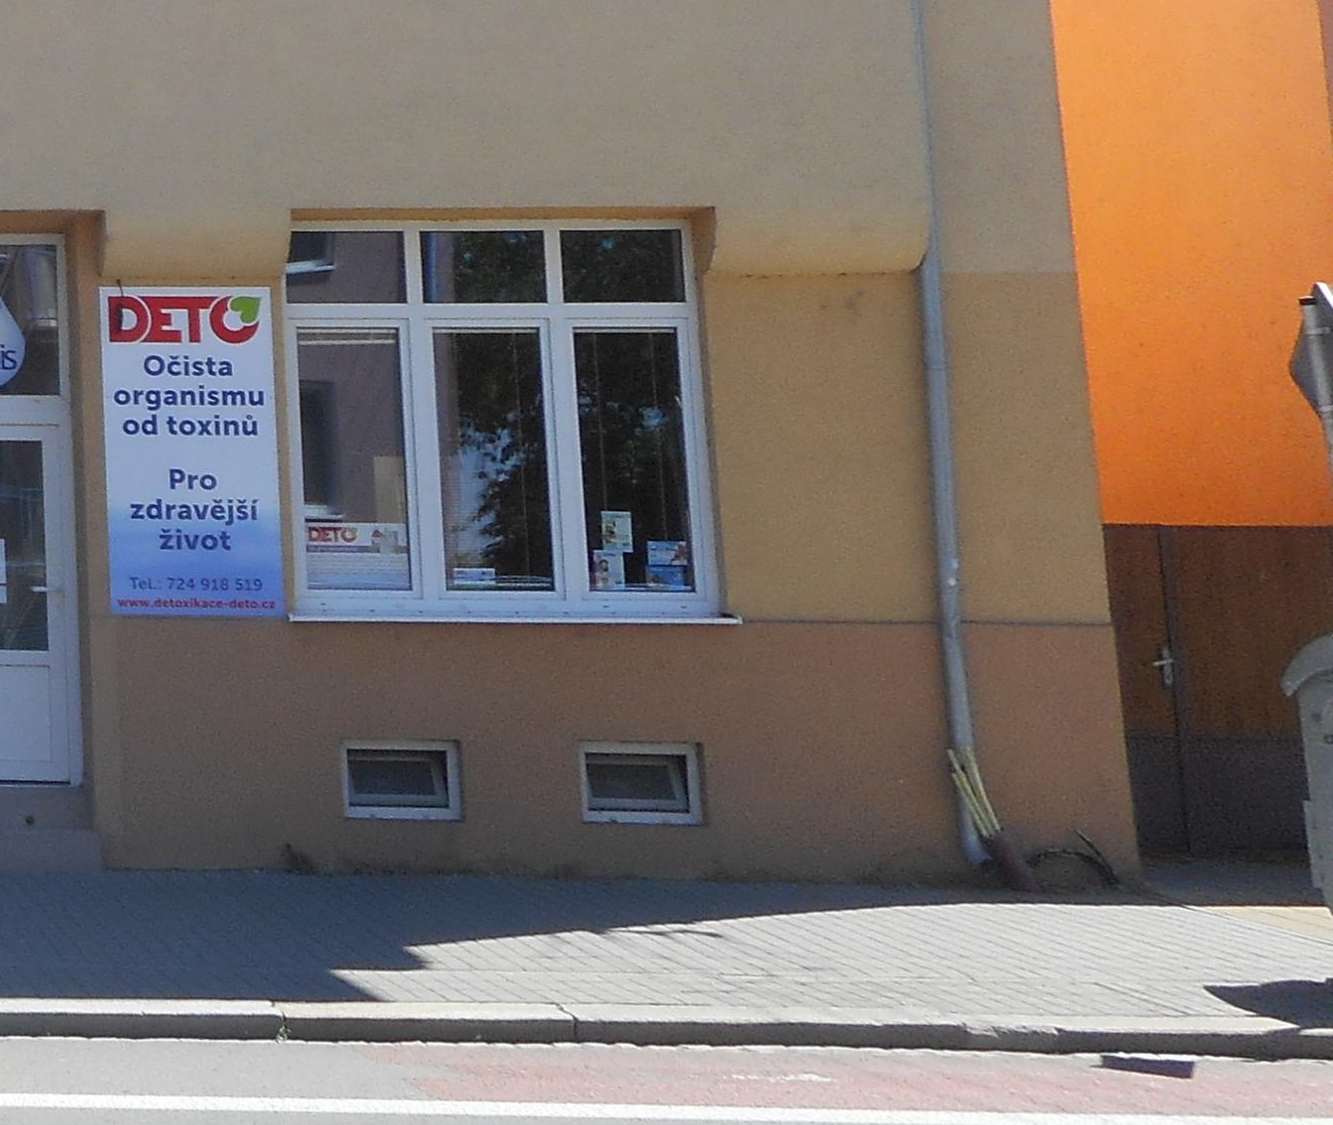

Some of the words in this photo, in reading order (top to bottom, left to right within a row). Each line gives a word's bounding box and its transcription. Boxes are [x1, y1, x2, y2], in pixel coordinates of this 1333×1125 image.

[107, 295, 261, 345] DETO
[143, 355, 233, 376] Očista
[113, 386, 264, 411] organismu
[122, 415, 158, 435] od
[166, 415, 258, 436] toxinů
[169, 469, 217, 490] Pro
[130, 499, 259, 526] zdravější
[159, 529, 232, 551] život
[166, 578, 196, 591] 724
[200, 578, 229, 591] 918
[235, 578, 263, 591] 519
